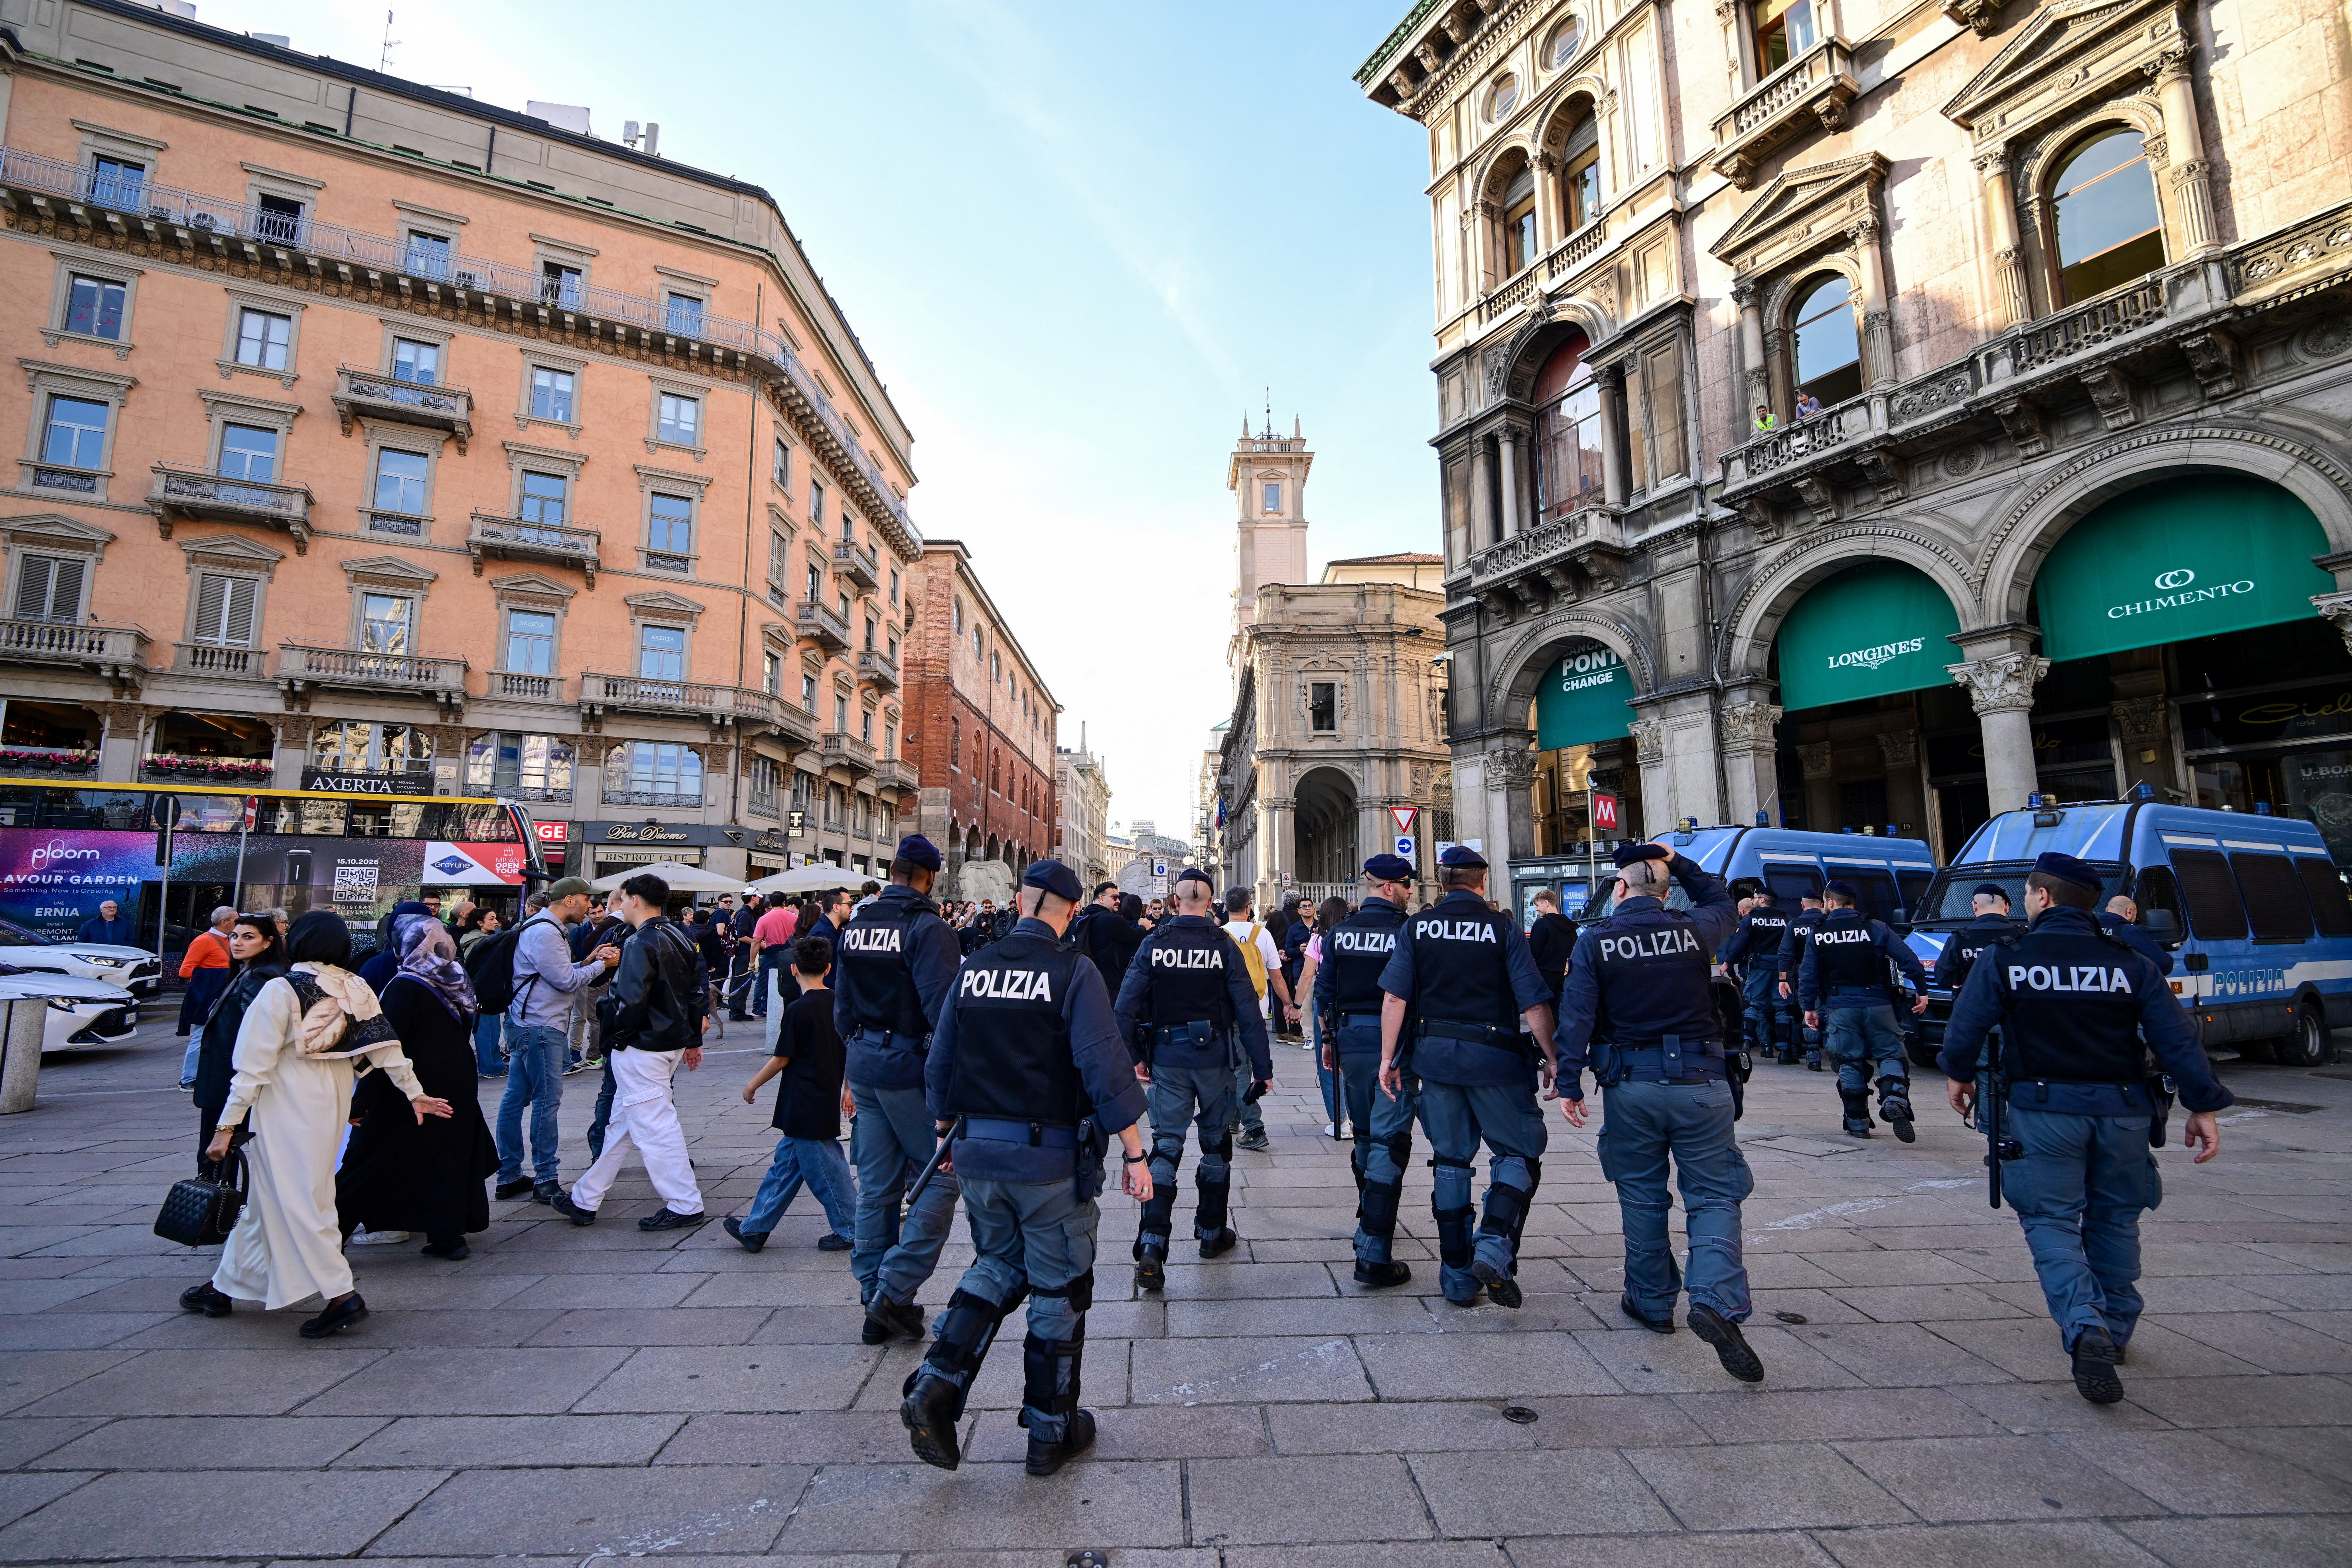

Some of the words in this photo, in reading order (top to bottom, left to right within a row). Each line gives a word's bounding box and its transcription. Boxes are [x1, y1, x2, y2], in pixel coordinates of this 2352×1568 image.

[2108, 580, 2254, 618] CHIMENTO
[1562, 648, 1625, 677] PONT
[1563, 672, 1613, 692] CHANGE
[1597, 801, 1615, 822] M
[606, 824, 638, 839] Bar
[639, 826, 688, 840] Duomo
[32, 839, 100, 870] ploom
[605, 853, 654, 862] BISTROT
[754, 858, 771, 866] BISTROT
[792, 856, 803, 865] change
[1562, 864, 1579, 873] POINT
[69, 875, 138, 885] GARDEN
[35, 907, 80, 917] ERNIA
[1416, 920, 1496, 943] POLIZIA
[1751, 918, 1786, 927] POLIZIA
[844, 928, 901, 952] POLIZIA
[1335, 932, 1396, 952] POLIZIA
[1600, 929, 1700, 961] POLIZIA
[1814, 929, 1871, 945] POLIZIA
[1151, 949, 1223, 969] POLIZIA
[960, 970, 1051, 1002] POLIZIA
[2008, 965, 2132, 994] POLIZIA
[2214, 968, 2284, 996] POLIZIA
